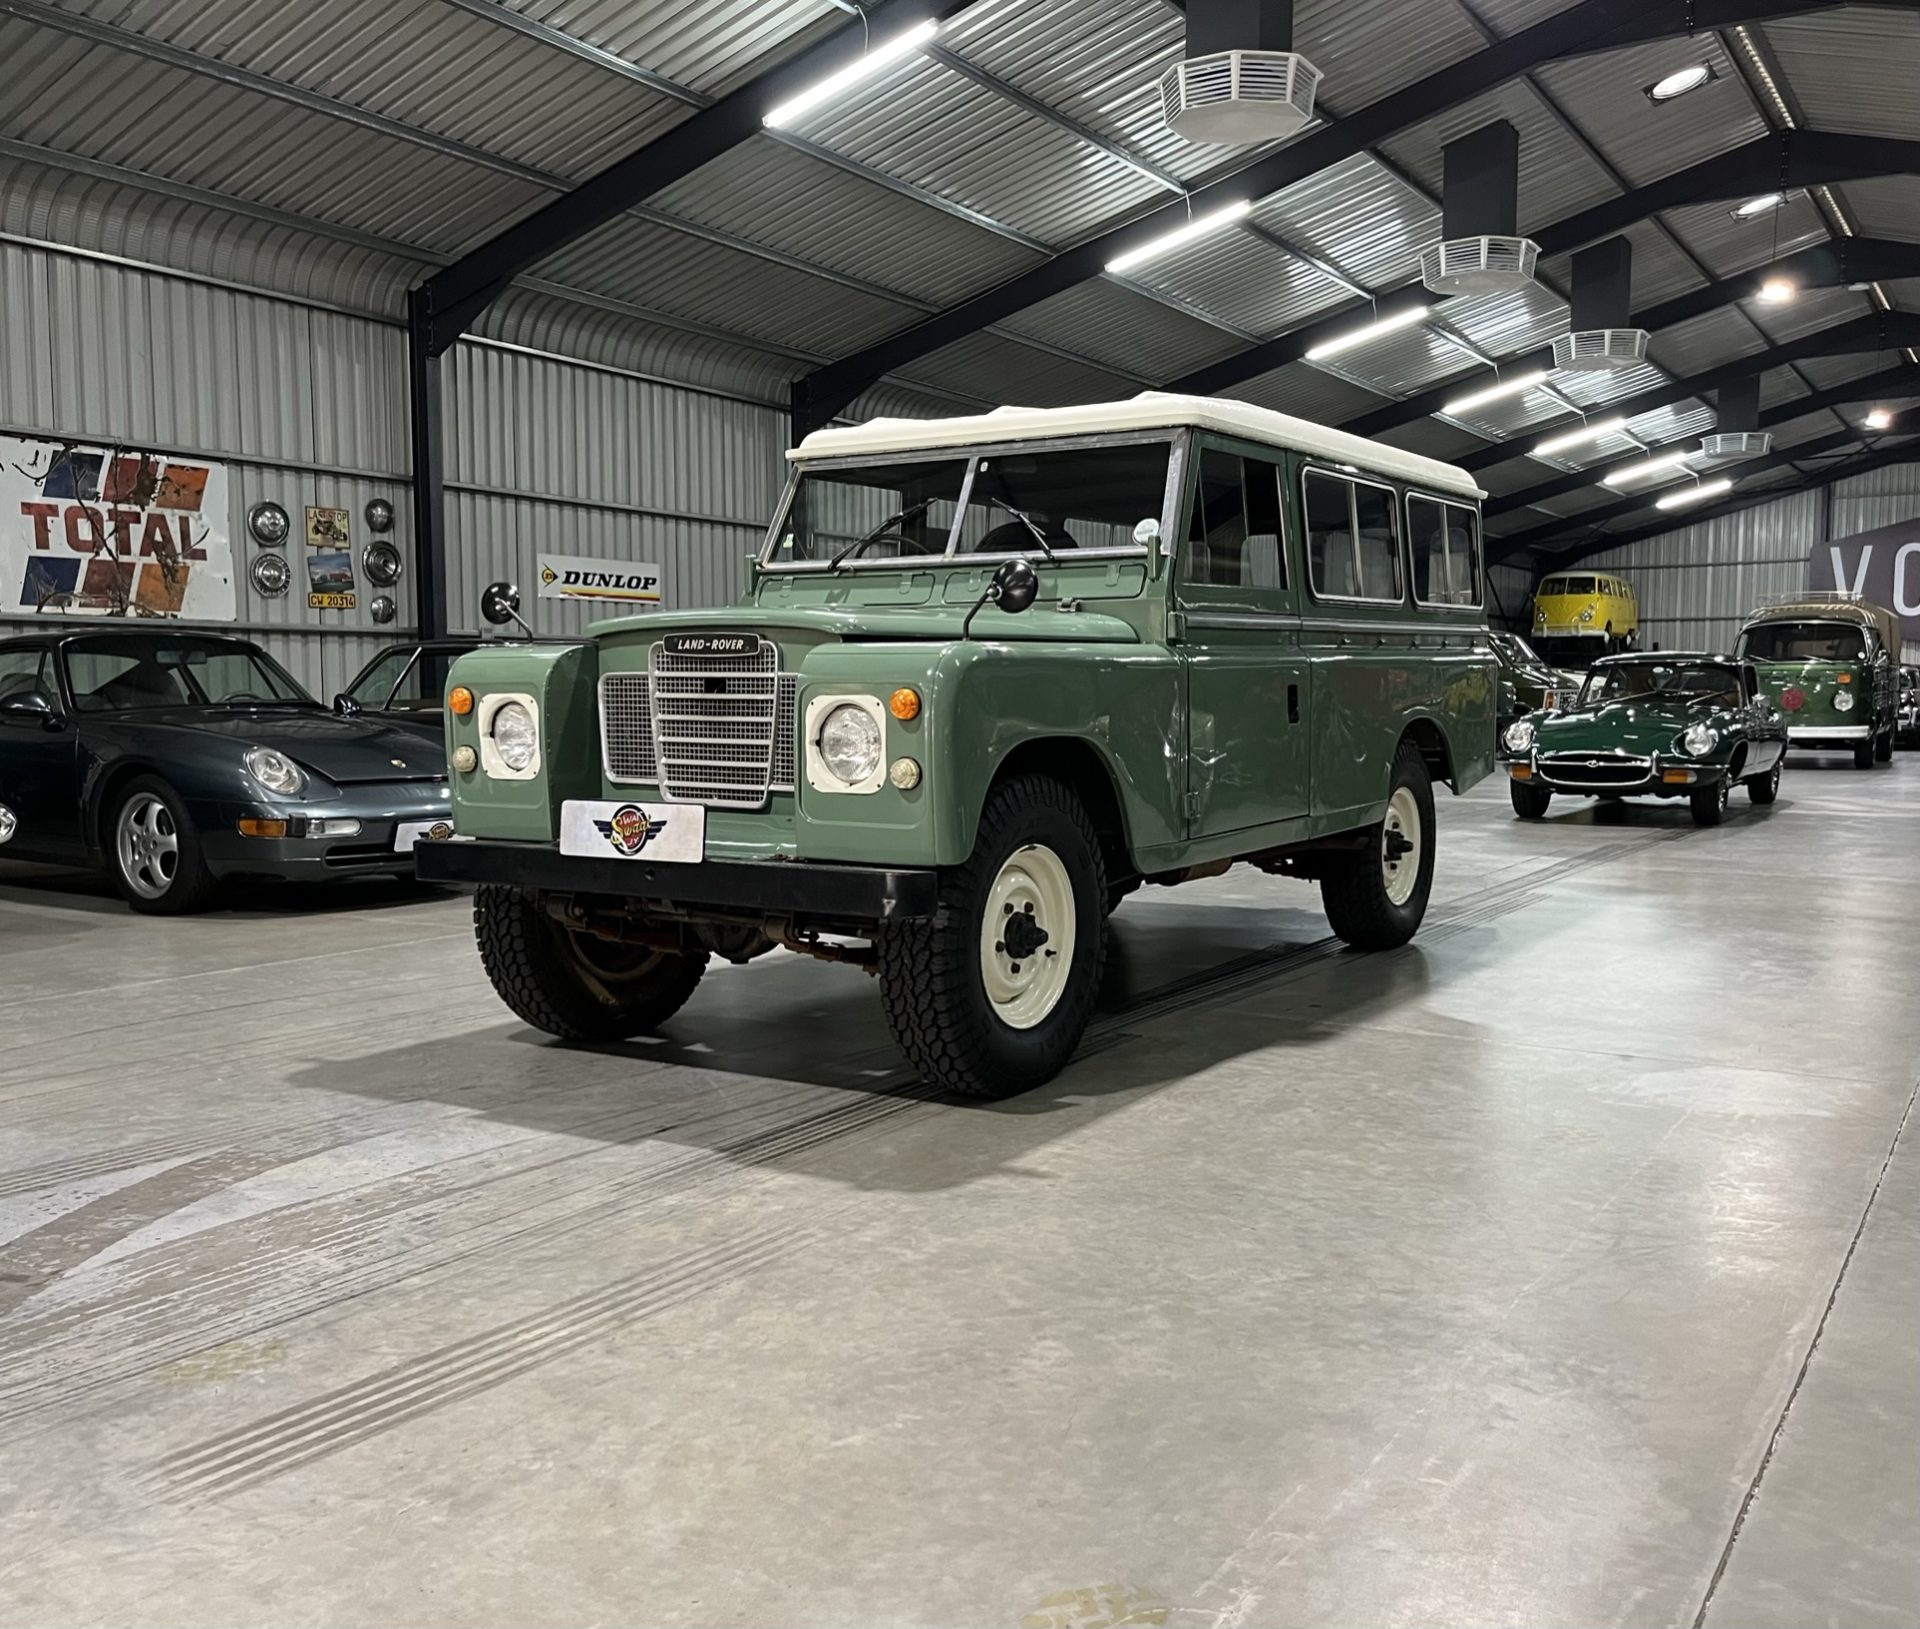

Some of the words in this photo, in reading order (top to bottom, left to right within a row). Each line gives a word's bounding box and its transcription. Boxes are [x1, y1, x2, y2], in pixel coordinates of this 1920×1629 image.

[328, 511, 347, 522] STOP
[21, 502, 207, 560] TOTAL
[562, 571, 657, 590] DUNLOP
[677, 639, 744, 650] LAND-ROVER
